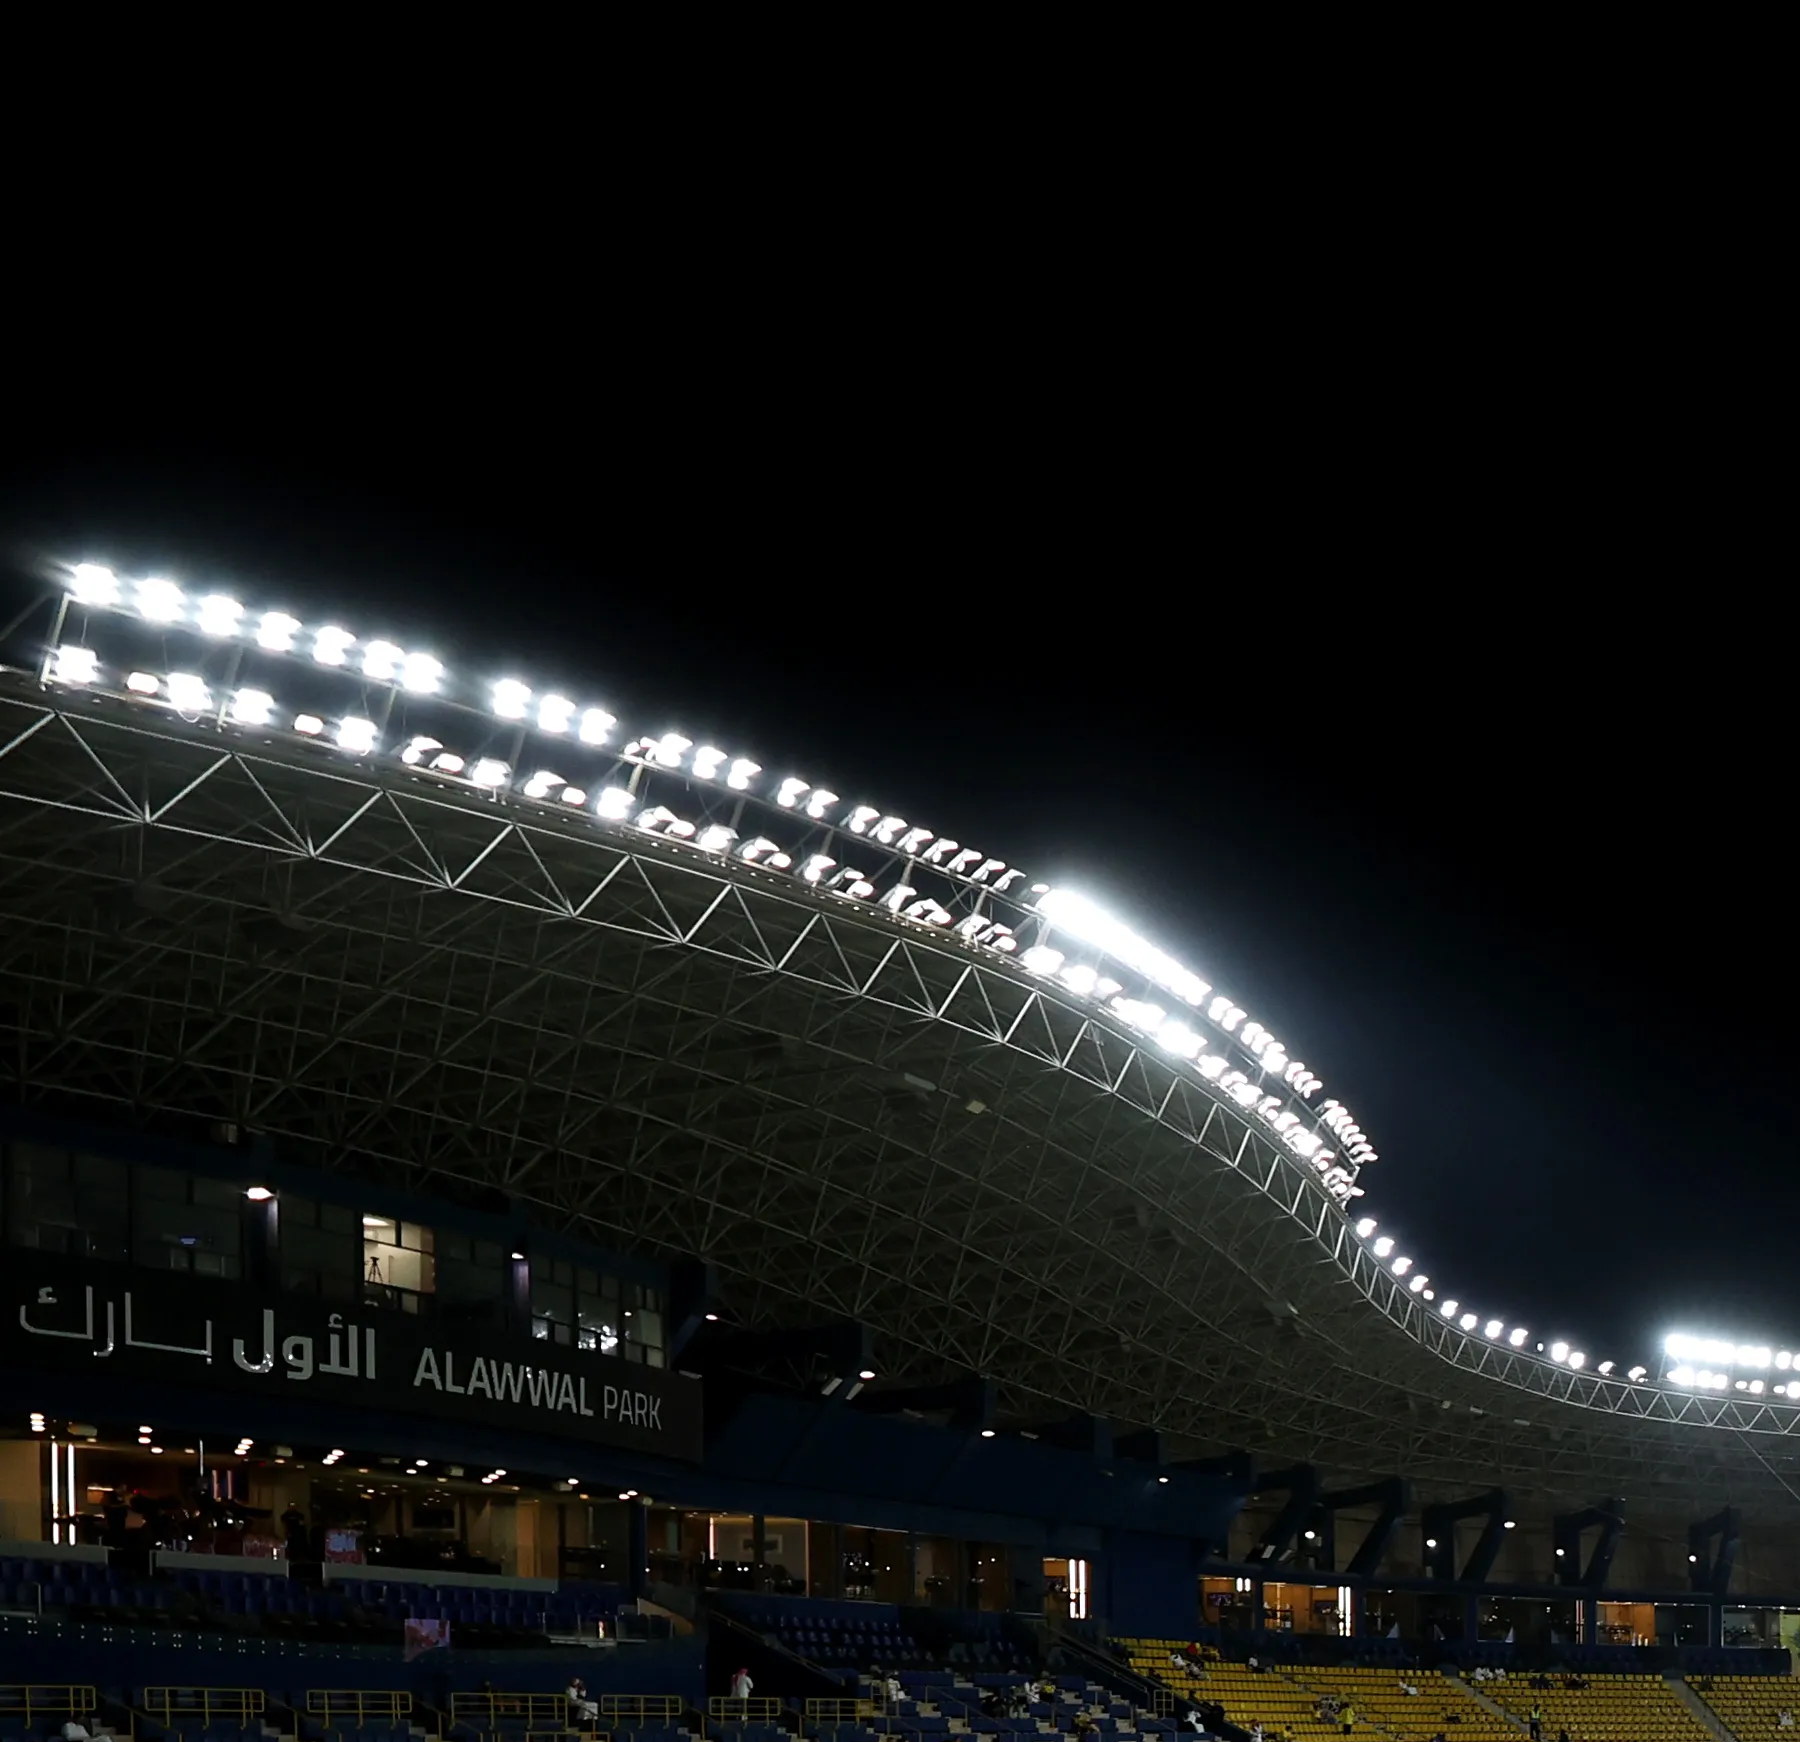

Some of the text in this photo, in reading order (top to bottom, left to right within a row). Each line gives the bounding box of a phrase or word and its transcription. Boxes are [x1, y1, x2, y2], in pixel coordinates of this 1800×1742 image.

[233, 1309, 376, 1380] الأول
[414, 1347, 662, 1431] ALAWWAL PARK
